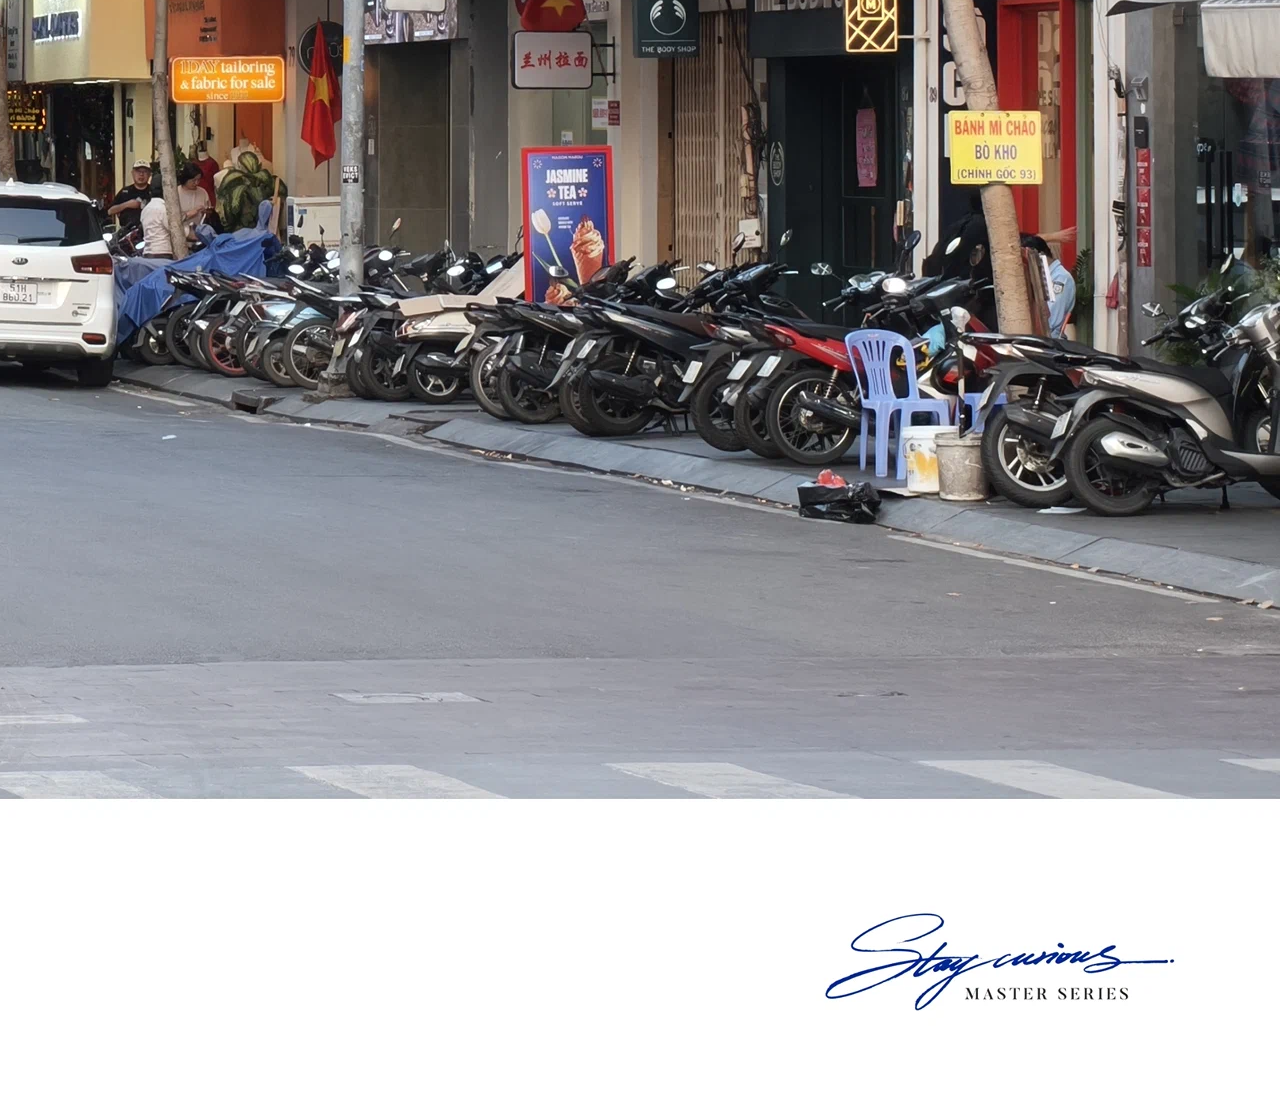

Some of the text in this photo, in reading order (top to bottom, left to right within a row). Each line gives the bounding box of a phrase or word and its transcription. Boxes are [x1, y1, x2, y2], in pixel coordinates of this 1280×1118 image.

[520, 50, 588, 70] 兰州拉面
[221, 60, 276, 77] tailoring
[180, 77, 276, 90] & fabric for sale
[206, 91, 229, 100] since
[954, 114, 1036, 136] BÁNH MÌ CHẢO
[975, 141, 1017, 160] BÒ KHO
[545, 169, 588, 183] JASMINE
[957, 165, 1036, 180] (CHÍNH GỐC 93)
[557, 185, 577, 200] TEA
[9, 284, 27, 293] 51H
